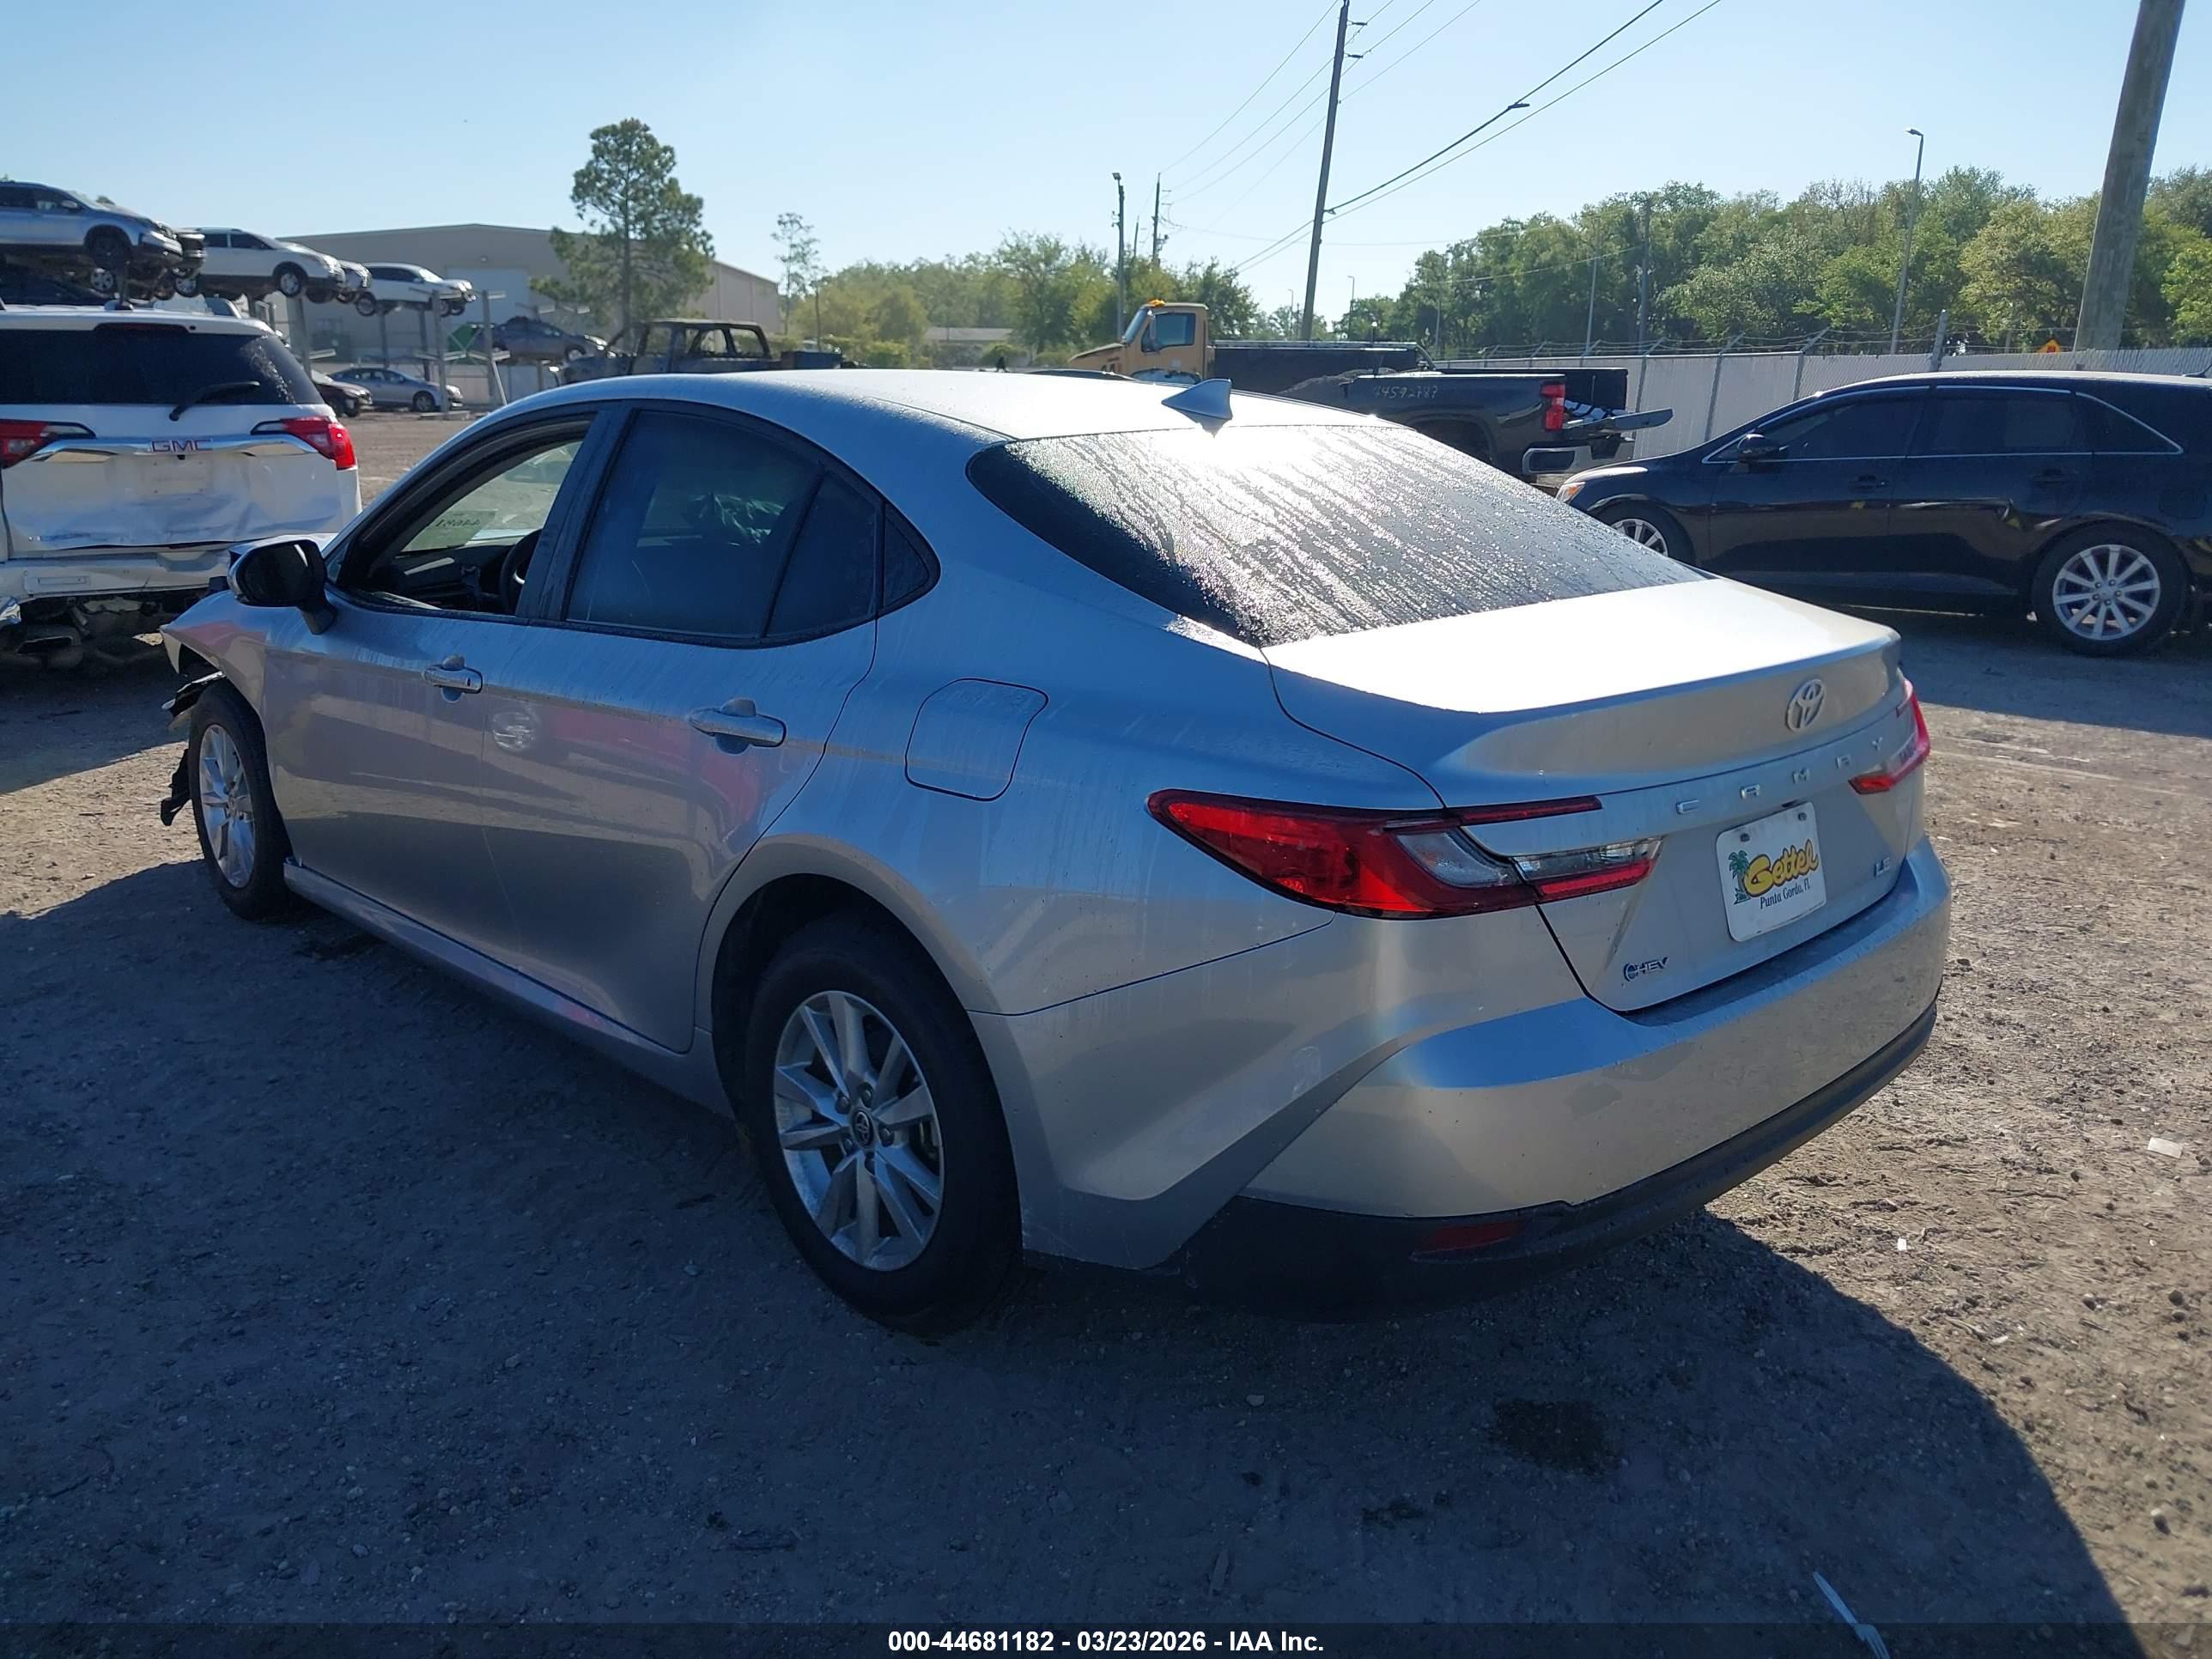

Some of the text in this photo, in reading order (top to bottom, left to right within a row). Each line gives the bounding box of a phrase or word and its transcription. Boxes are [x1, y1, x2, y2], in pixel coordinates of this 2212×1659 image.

[151, 439, 213, 453] GMC
[1675, 737, 1883, 815] CAMRY
[1743, 838, 1819, 897] Gettel
[1873, 857, 1891, 877] LE
[1759, 893, 1782, 909] Punta
[1783, 883, 1804, 899] Gorda,
